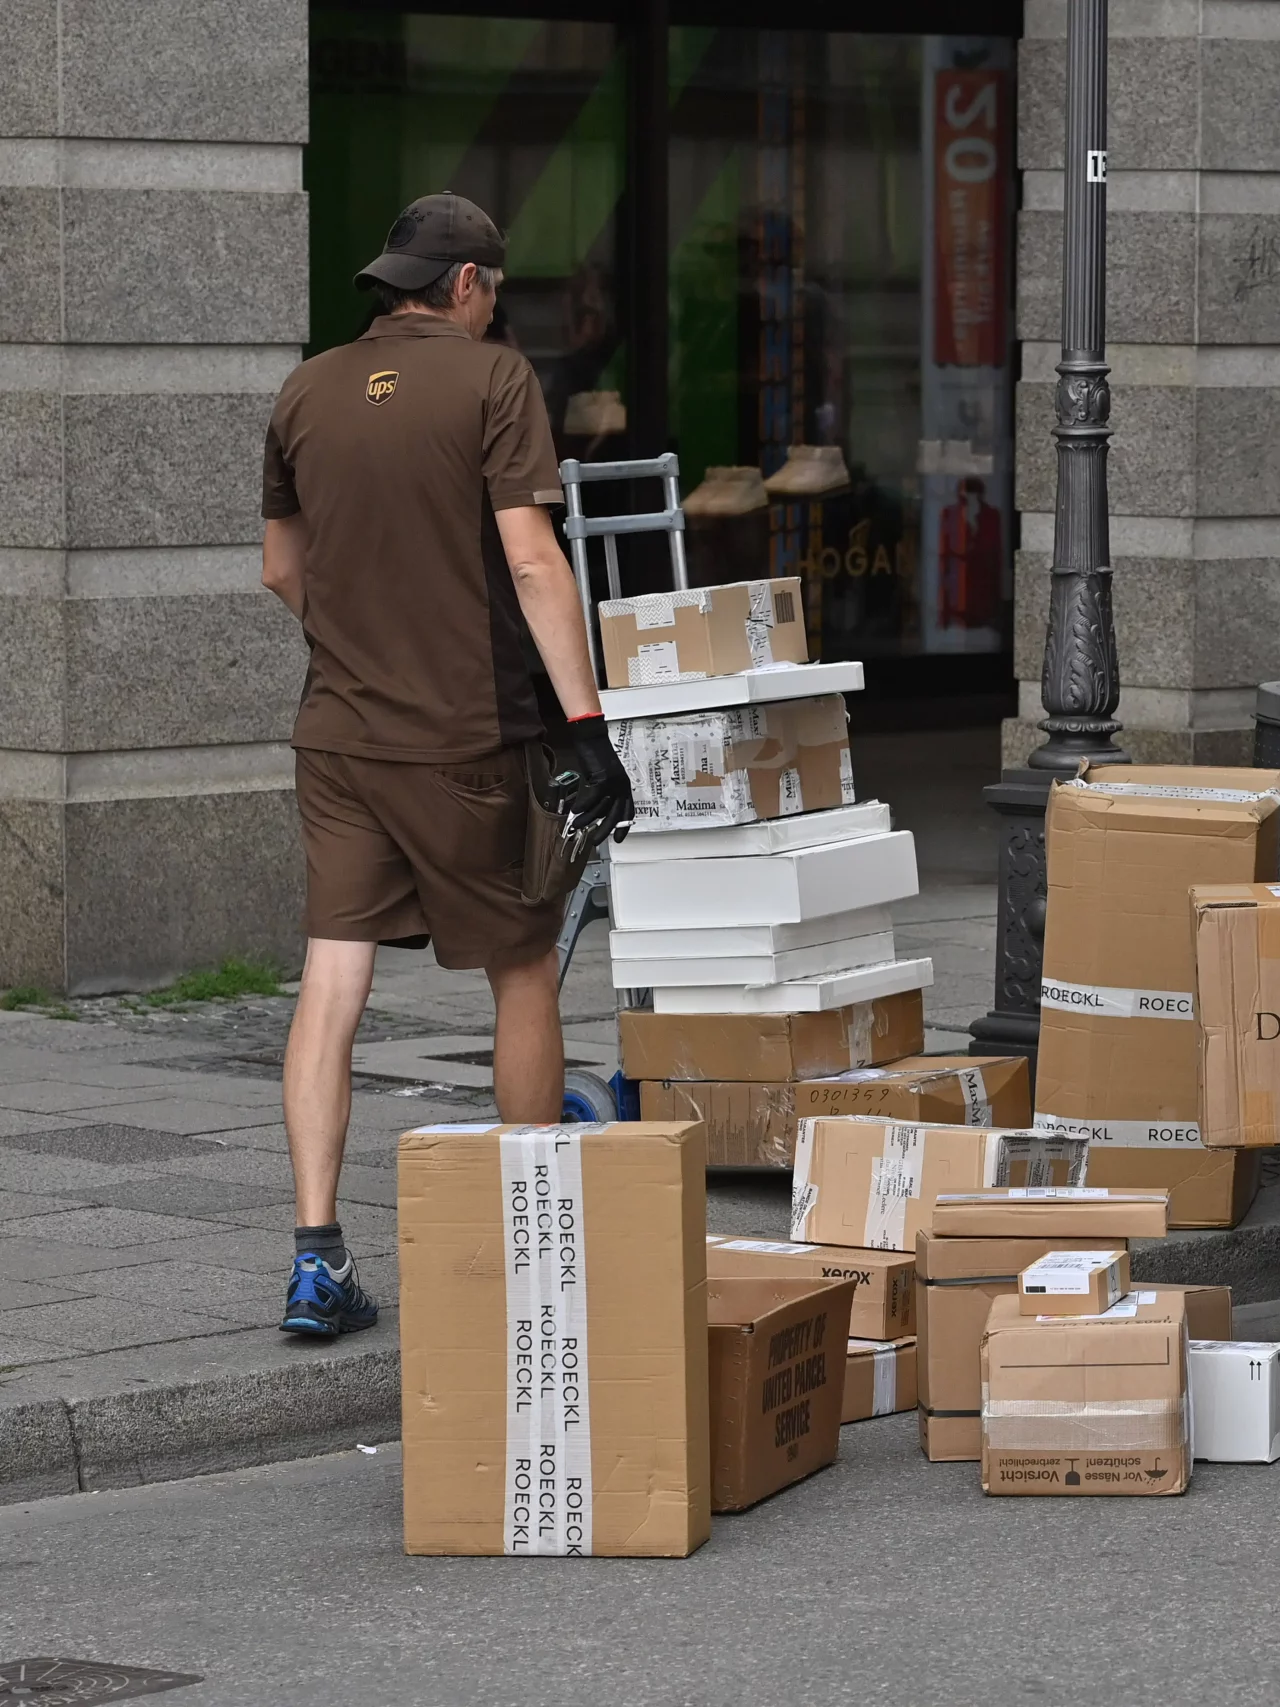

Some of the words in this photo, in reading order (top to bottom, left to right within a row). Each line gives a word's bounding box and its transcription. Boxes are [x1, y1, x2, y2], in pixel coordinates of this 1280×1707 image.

[368, 380, 394, 400] ups
[676, 799, 716, 812] Maxima
[1041, 985, 1104, 1007] ROECKL
[1140, 997, 1194, 1013] ROEC
[512, 1181, 530, 1275] ROECKL
[535, 1165, 553, 1259] ROECKL
[557, 1198, 576, 1292] ROECKL
[822, 1267, 871, 1285] xerox
[517, 1320, 532, 1413] ROECKL
[541, 1304, 557, 1399] ROECKL
[768, 1318, 813, 1370] PROPERTY
[813, 1312, 828, 1348] OF
[561, 1337, 580, 1432] ROECKL
[762, 1376, 792, 1415] UNITED
[794, 1352, 827, 1396] PARCEL
[775, 1400, 811, 1448] SERVICE
[539, 1444, 555, 1537] ROECKL
[1000, 1458, 1060, 1467] zerbrechlich!
[1086, 1458, 1141, 1468] schützen!
[1001, 1470, 1060, 1482] Vorsicht
[1085, 1471, 1120, 1482] Nässe
[1123, 1472, 1143, 1482] Vor
[513, 1458, 531, 1551] ROECKL
